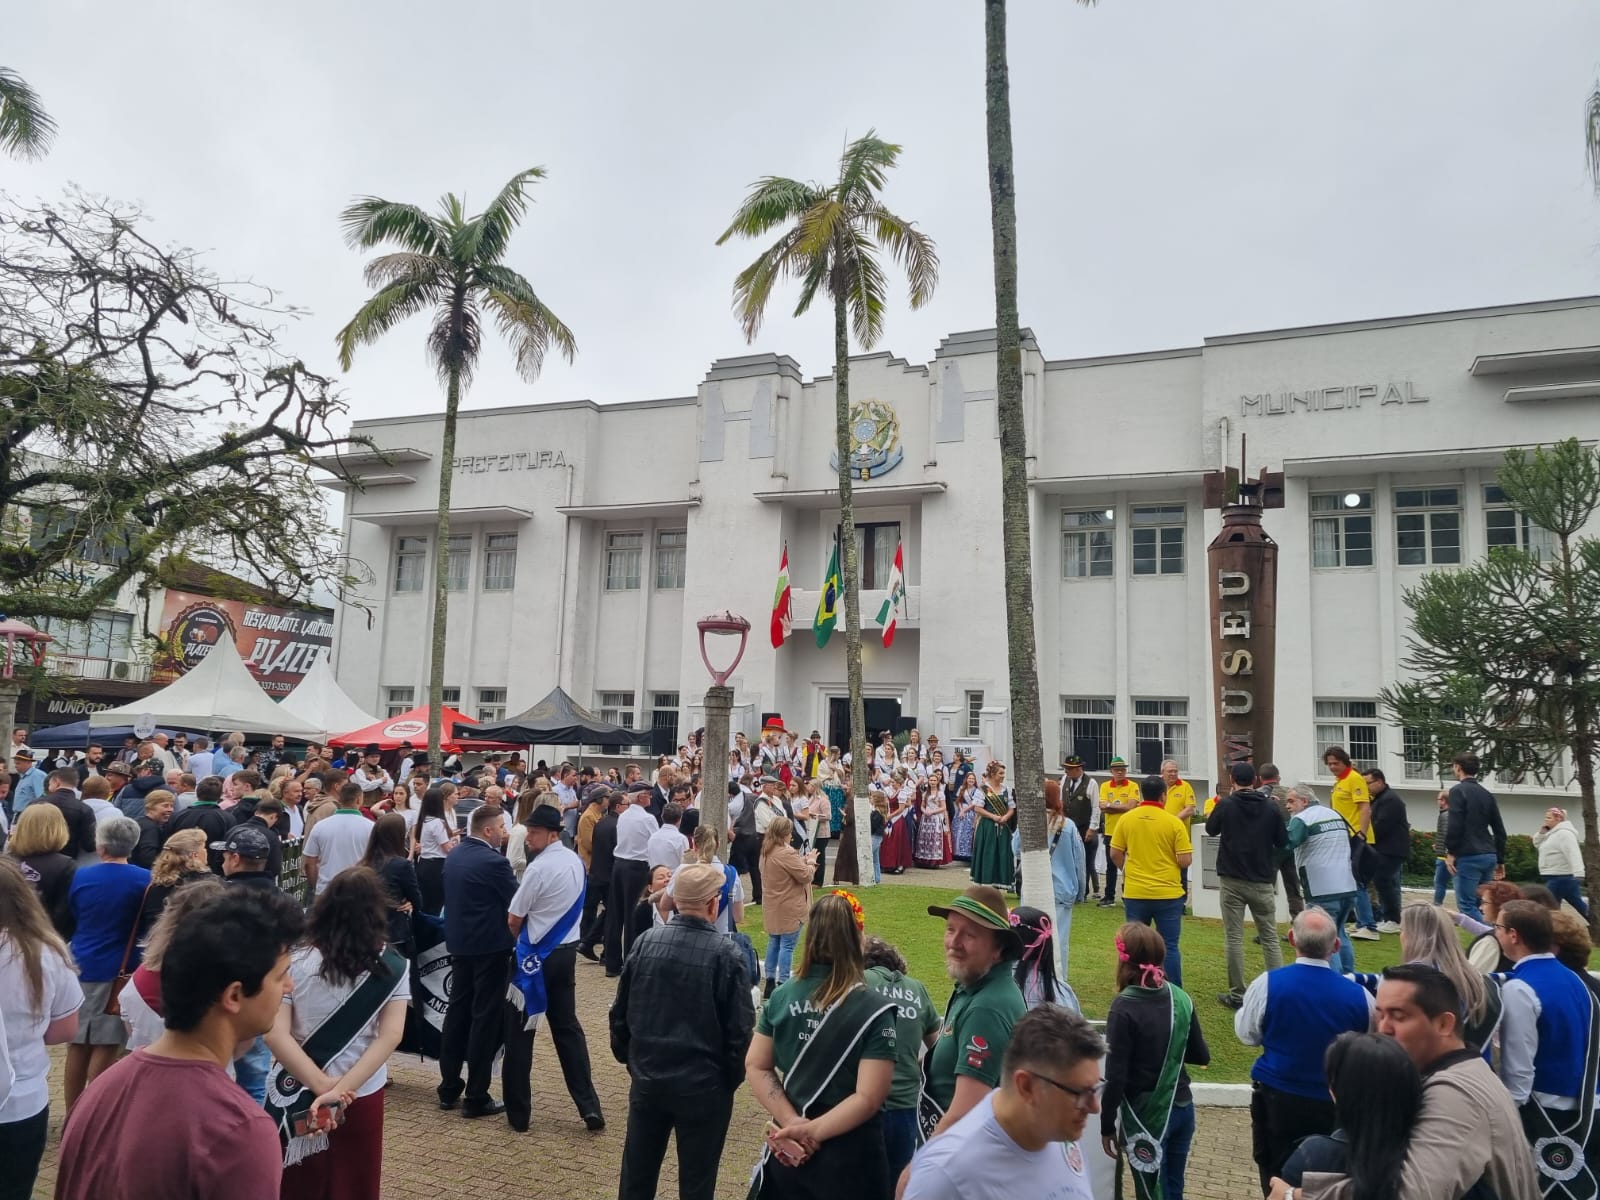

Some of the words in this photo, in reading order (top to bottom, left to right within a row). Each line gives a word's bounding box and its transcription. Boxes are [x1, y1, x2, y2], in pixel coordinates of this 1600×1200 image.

[1239, 381, 1430, 417] MUNICIPAL
[1218, 568, 1253, 772] MUSEU
[47, 700, 95, 714] MUNDO
